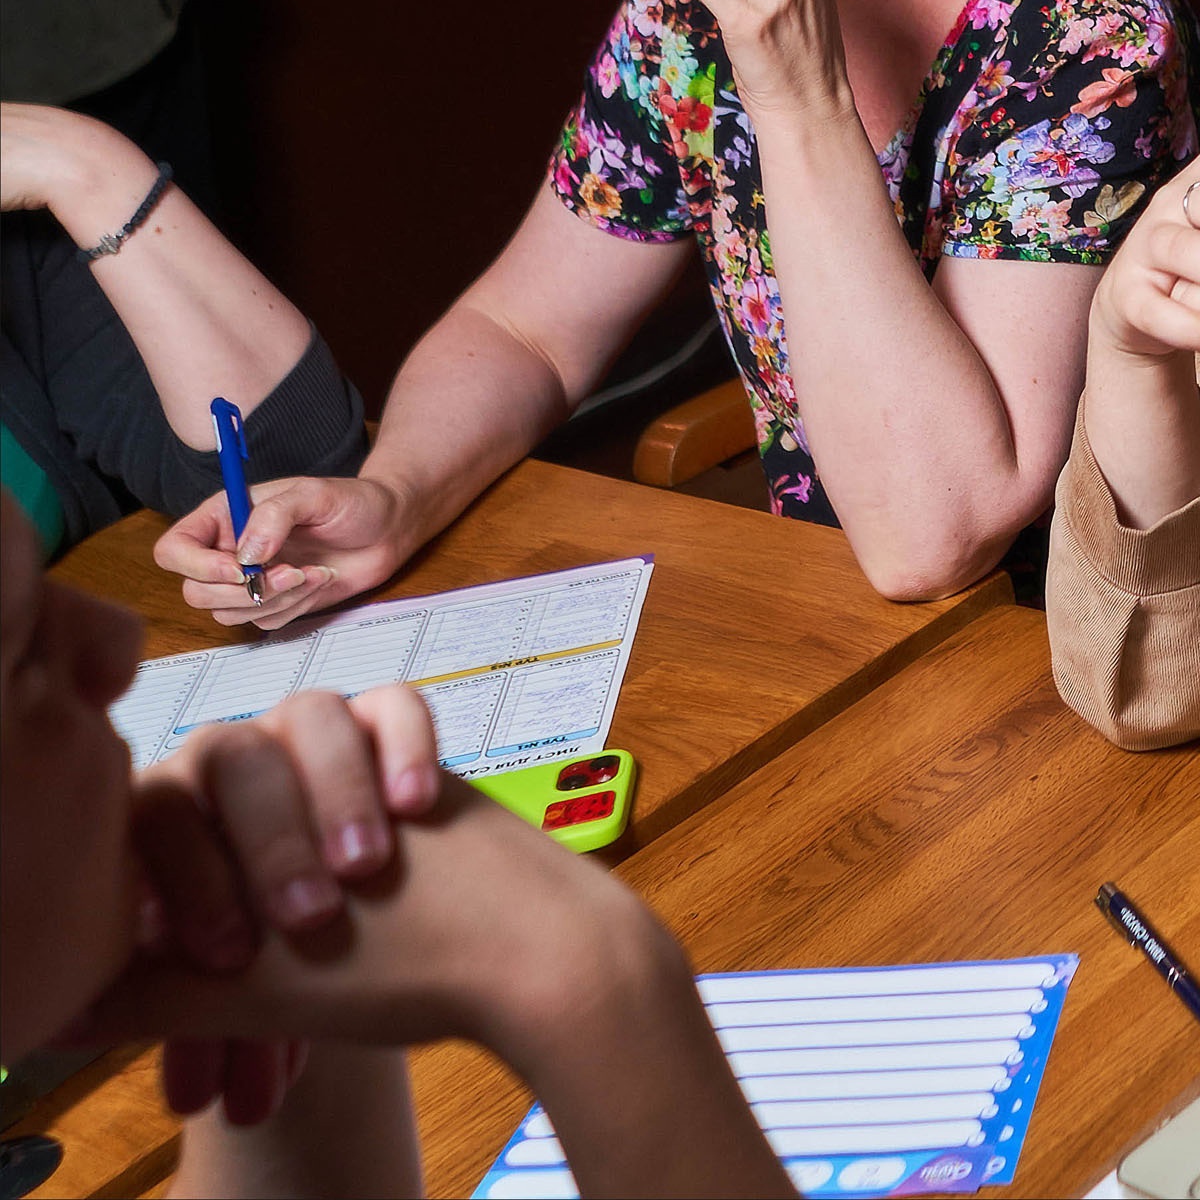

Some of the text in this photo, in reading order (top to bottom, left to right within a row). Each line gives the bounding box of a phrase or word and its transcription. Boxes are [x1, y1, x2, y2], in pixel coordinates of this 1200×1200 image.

[515, 656, 540, 666] ТУР
[517, 736, 568, 751] ТУР №1
[454, 745, 581, 778] ЛИСТ ДЛЯ САМ
